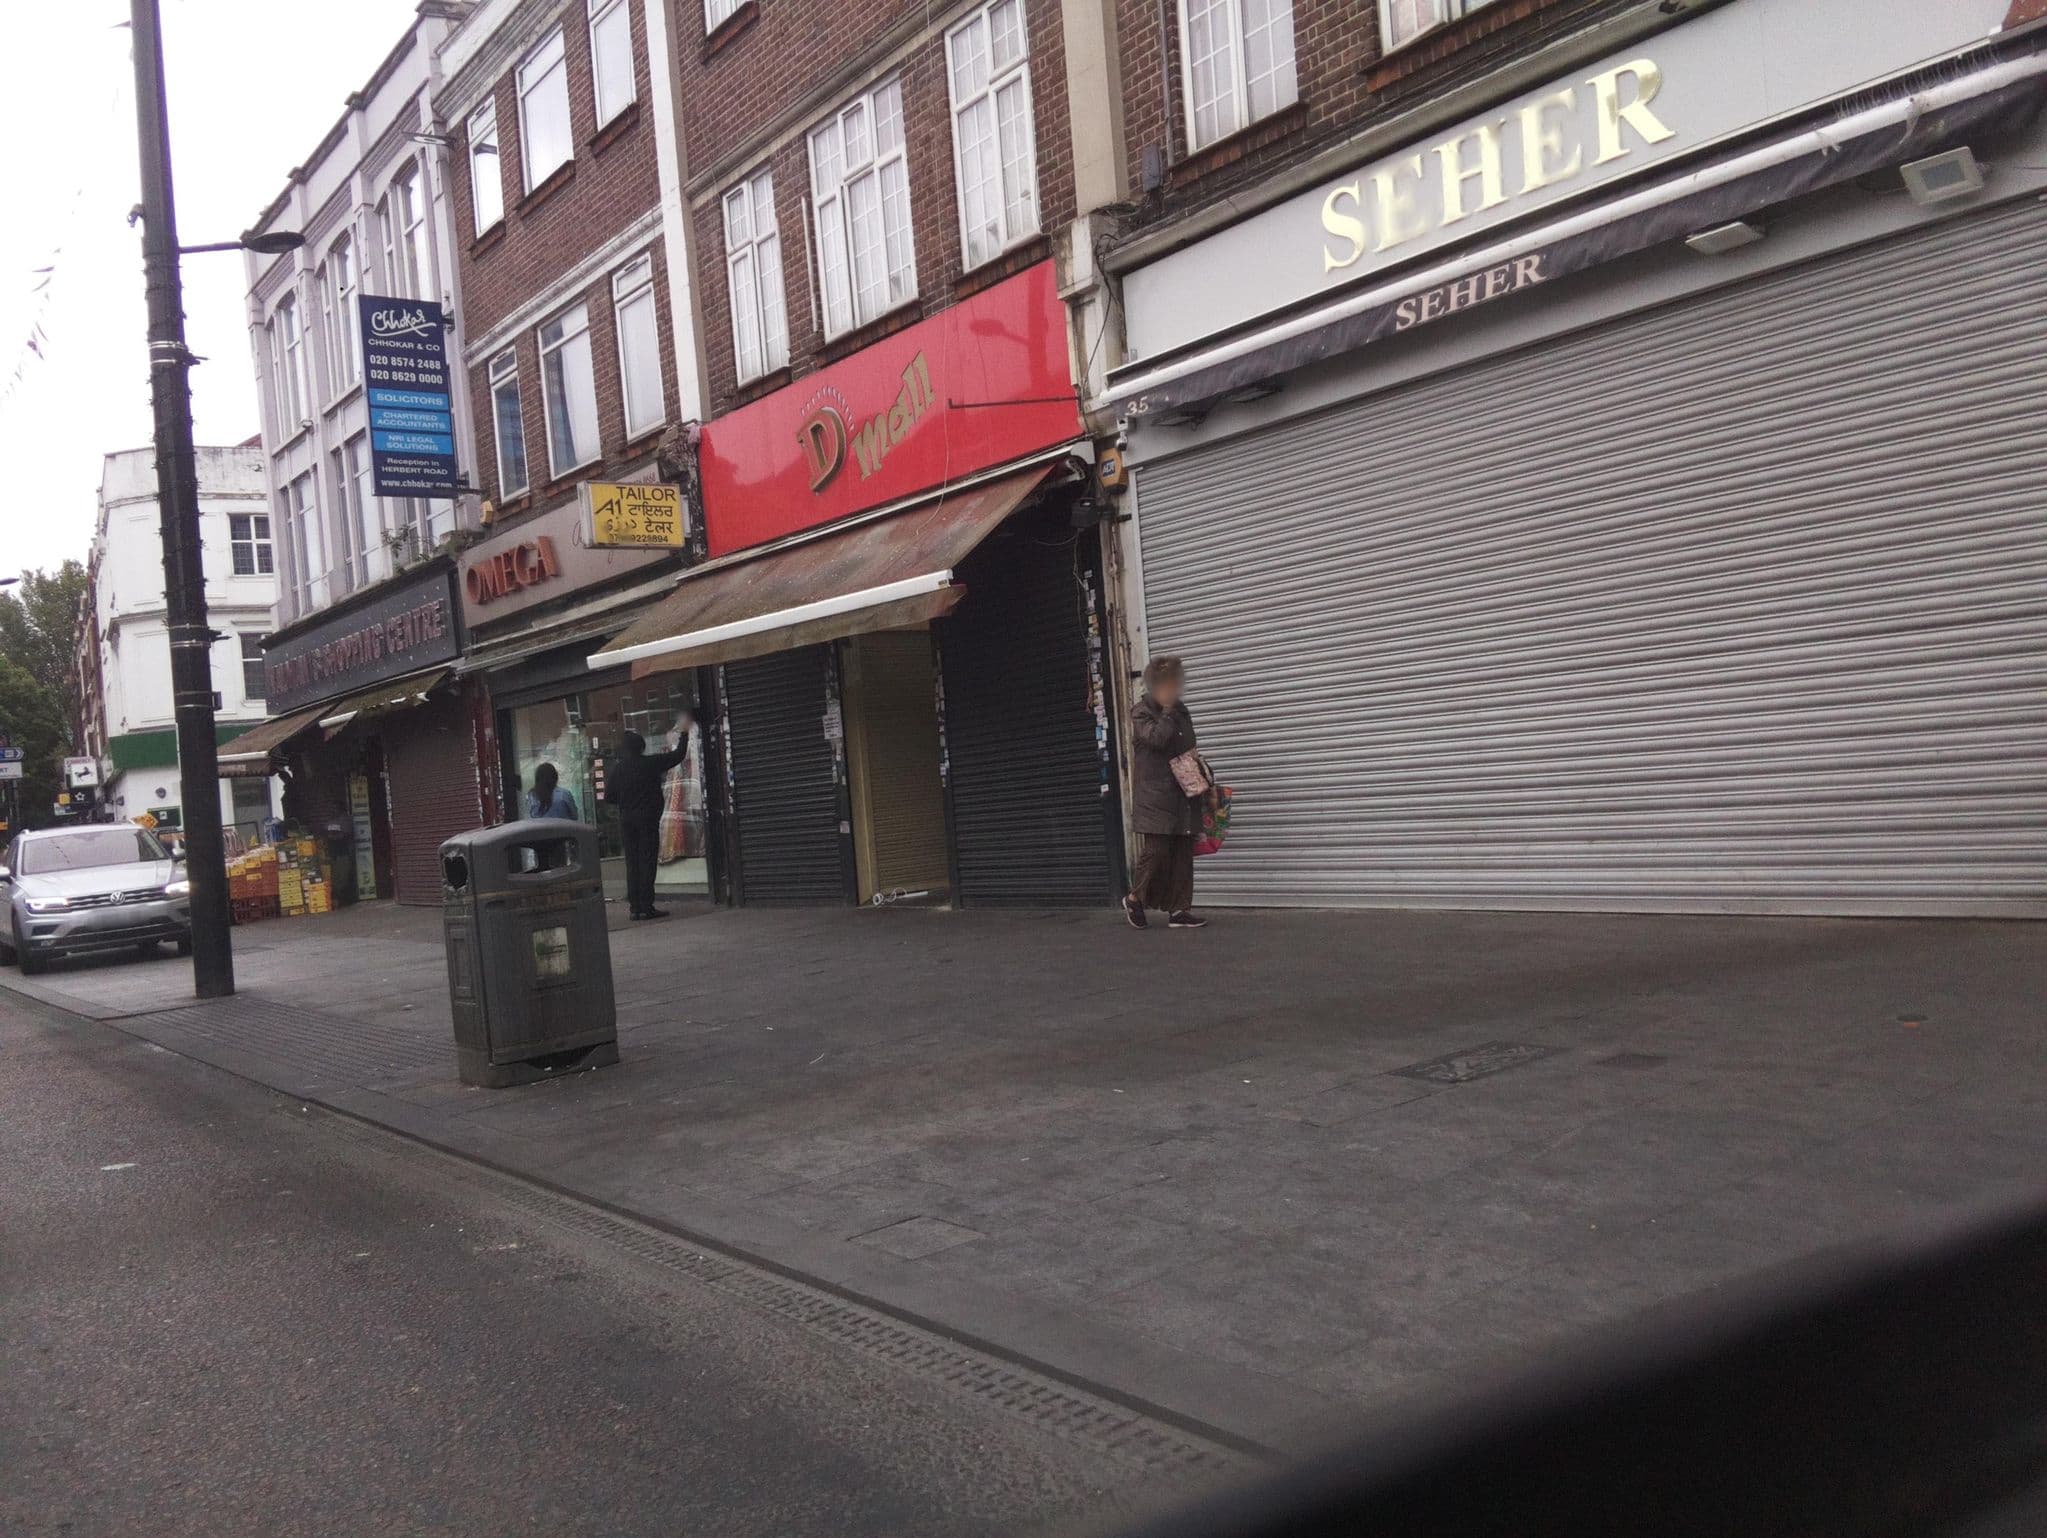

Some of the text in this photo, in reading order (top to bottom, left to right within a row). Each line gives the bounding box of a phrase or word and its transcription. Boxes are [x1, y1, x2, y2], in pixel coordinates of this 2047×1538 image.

[1320, 57, 1677, 273] SEHER
[1394, 254, 1546, 332] SEHER
[368, 338, 414, 350] CHHOKAR
[369, 354, 388, 365] 020
[390, 356, 415, 367] 8574
[370, 369, 443, 384] 020 8629 0000
[376, 393, 444, 406] SOLICITORS
[1126, 396, 1149, 416] 35
[383, 412, 438, 421] CHARTERED
[377, 419, 446, 429] ACCOUNTANTS
[386, 442, 439, 451] SOLUTIONS
[406, 436, 434, 444] LEGAL
[386, 457, 430, 467] Reception
[381, 466, 421, 474] HERBERT
[616, 486, 676, 501] TAILOR
[627, 501, 673, 517] ਟਾਇਲਰ
[466, 535, 561, 606] OMEGA
